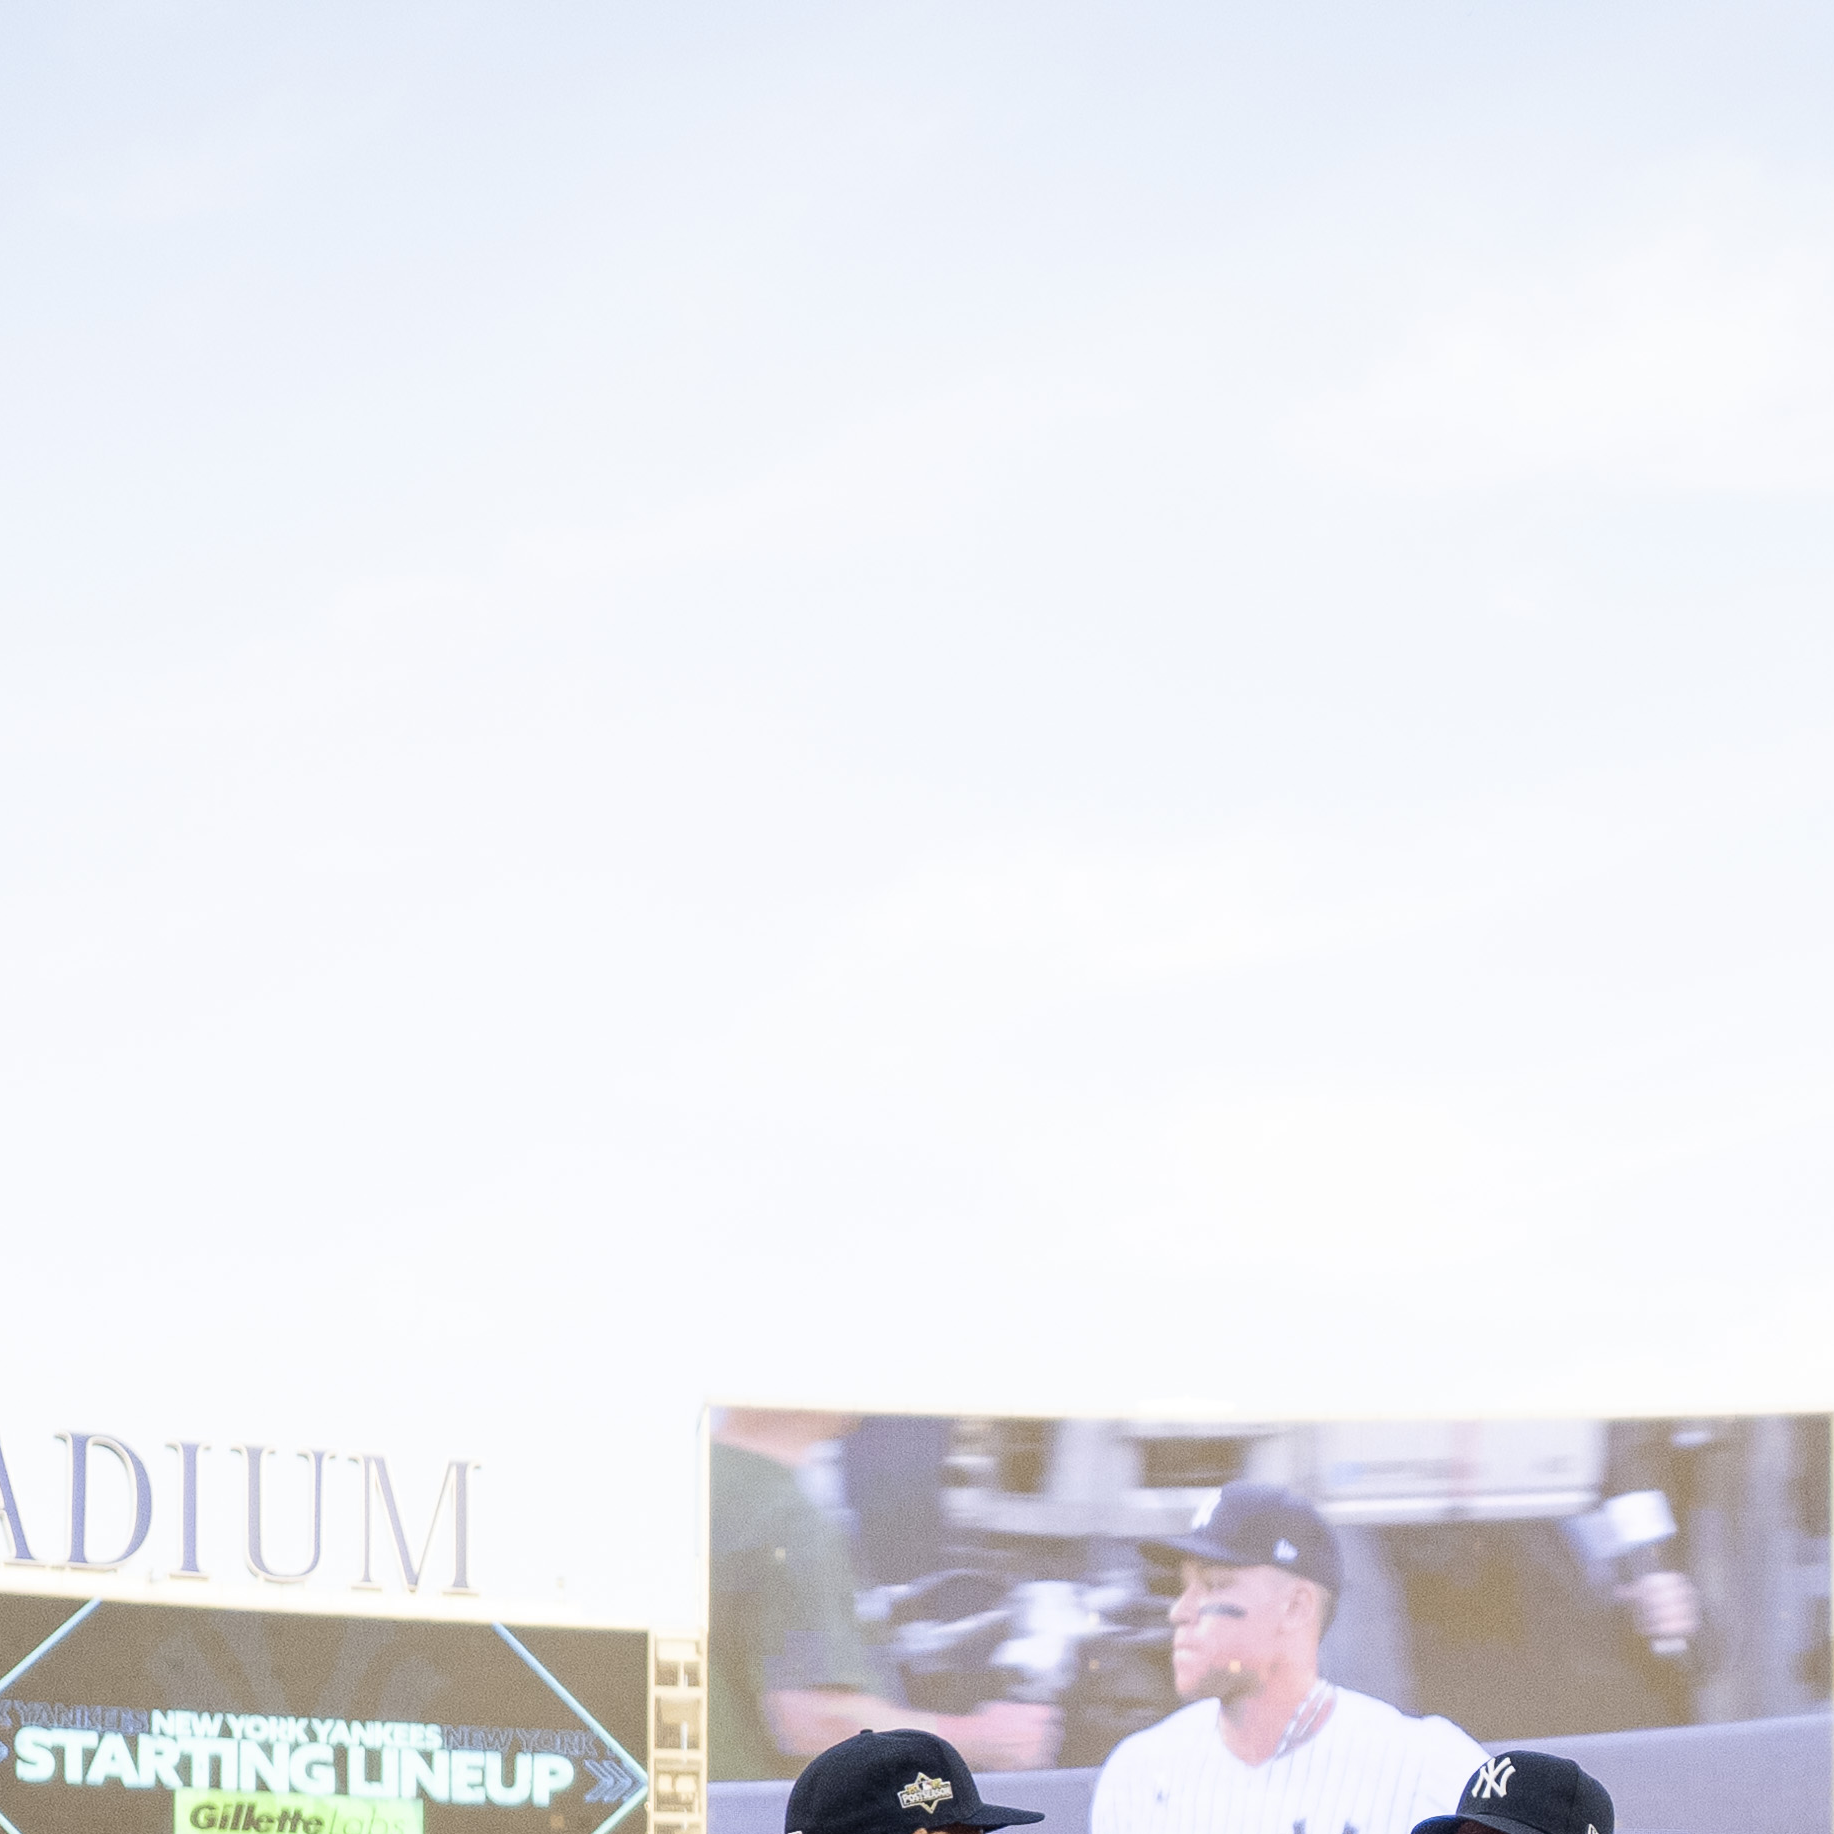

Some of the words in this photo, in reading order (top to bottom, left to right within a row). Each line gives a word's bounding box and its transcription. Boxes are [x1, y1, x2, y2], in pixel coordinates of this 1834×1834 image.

[151, 1709, 223, 1739] NEW
[225, 1712, 309, 1744] YORK
[311, 1716, 443, 1750] YANKEES
[13, 1726, 337, 1796] STARTING
[347, 1745, 576, 1809] LINEUP
